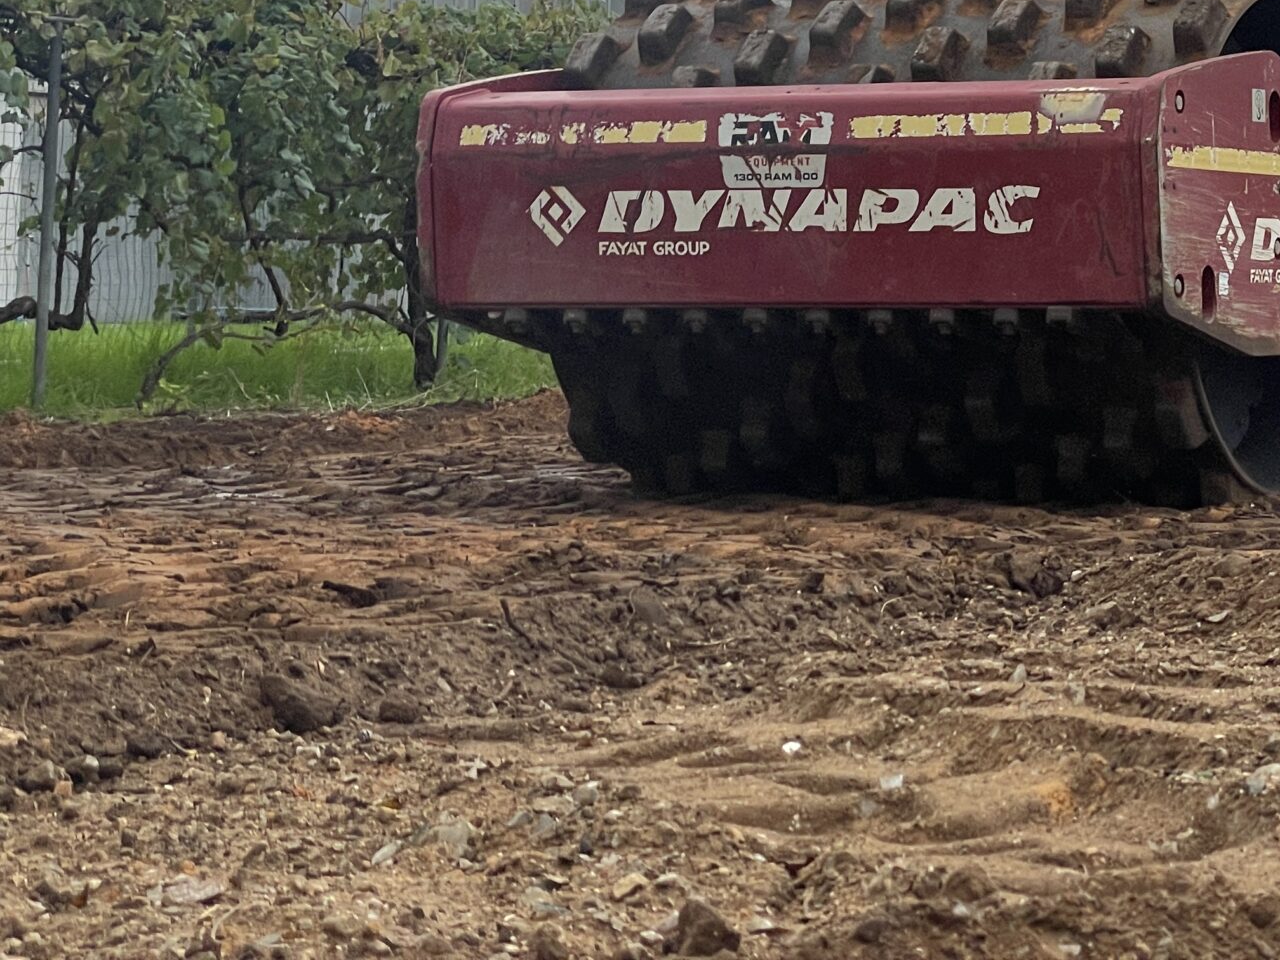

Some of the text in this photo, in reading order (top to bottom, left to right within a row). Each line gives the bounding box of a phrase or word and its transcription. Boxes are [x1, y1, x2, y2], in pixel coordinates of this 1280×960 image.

[764, 173, 792, 181] RAM
[597, 185, 1041, 234] DYNAPAC
[598, 241, 710, 256] FAYAT GROUP
[1250, 269, 1273, 283] FAYAT
